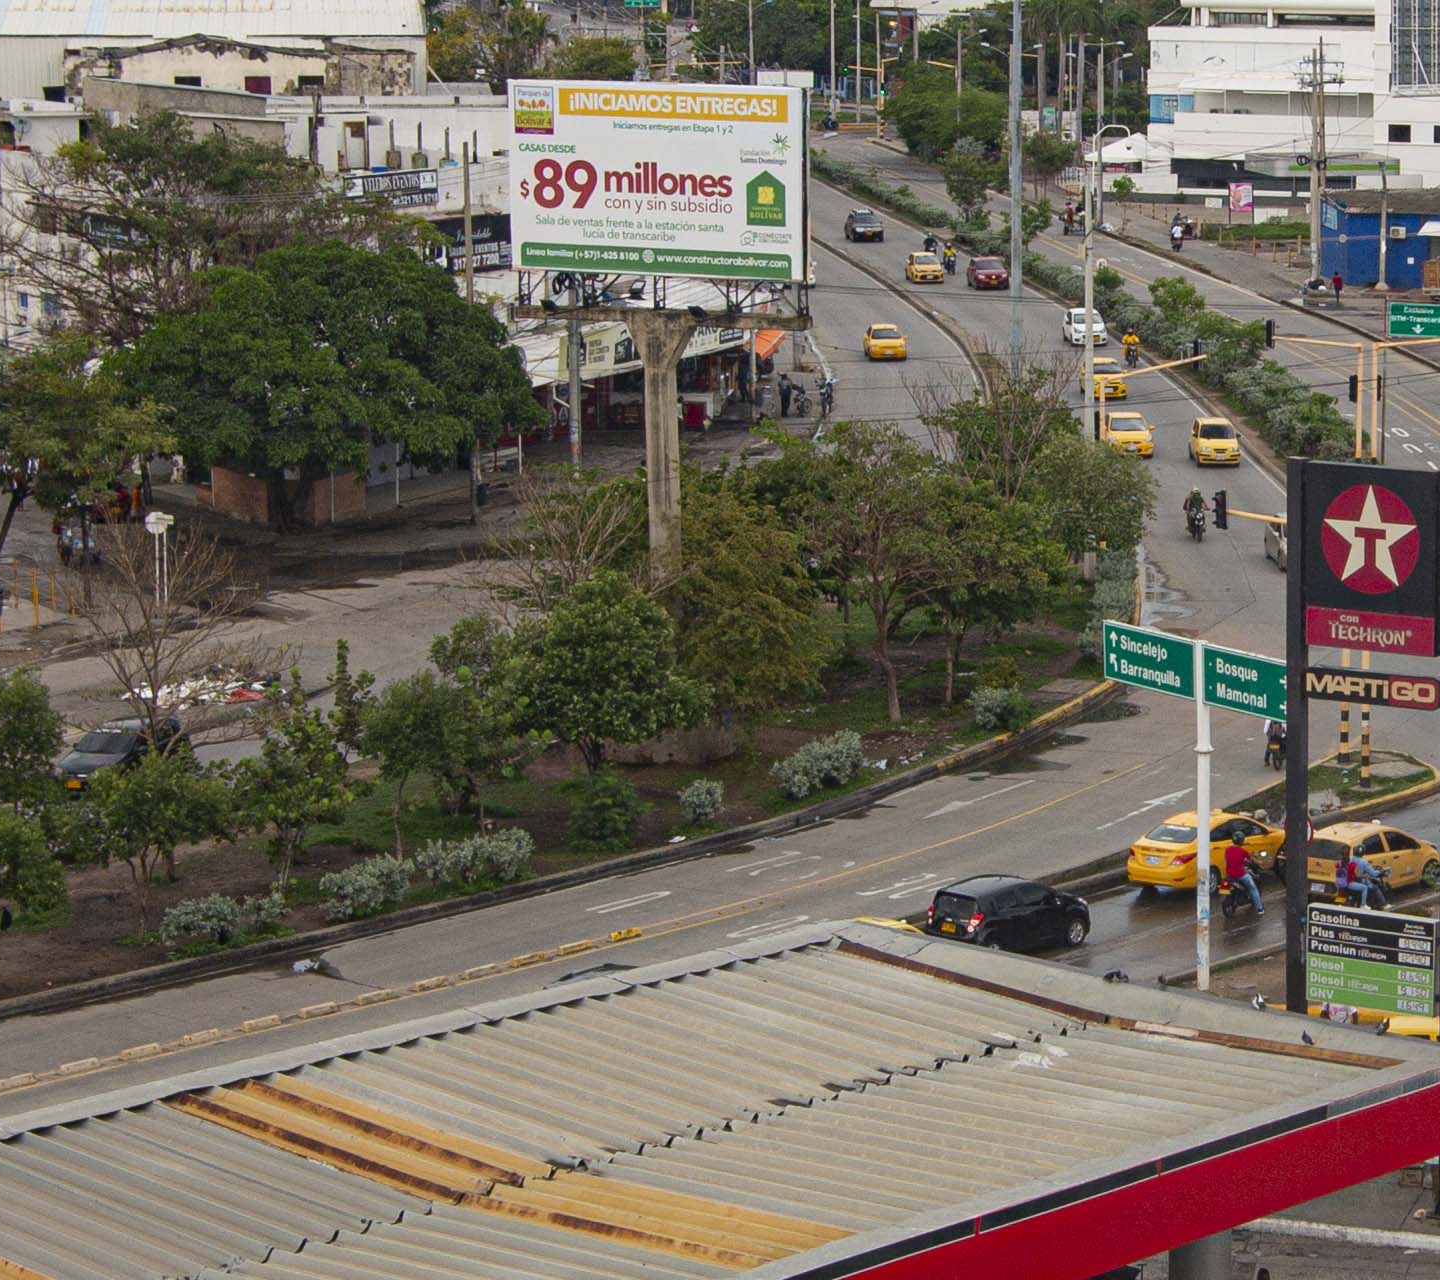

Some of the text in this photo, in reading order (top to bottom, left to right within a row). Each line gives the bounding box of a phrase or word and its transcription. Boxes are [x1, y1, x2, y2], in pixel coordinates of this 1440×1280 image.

[569, 92, 777, 117] ¡INICIAMOS ENTREGAS!
[613, 121, 647, 131] Iniciamos
[692, 124, 714, 134] Etapa
[519, 143, 576, 154] CASAS DESDE
[604, 162, 732, 198] millones
[605, 197, 733, 214] con y sin subsidio
[536, 214, 554, 225] Sala
[557, 215, 569, 226] de
[572, 217, 604, 228] ventas
[606, 216, 634, 229] frente
[644, 218, 653, 229] la
[655, 219, 696, 231] estación
[698, 222, 724, 232] santa
[607, 230, 620, 241] de
[622, 230, 676, 242] transcaribe
[547, 248, 574, 258] familiar
[620, 252, 639, 261] 8100
[657, 254, 788, 269] www.constructorabolivar.com
[1340, 614, 1359, 624] con
[1120, 634, 1168, 662] Sincelejo
[1120, 659, 1181, 688] Barranquilla
[1216, 658, 1258, 682] Bosque
[1216, 682, 1267, 709] Mamonal
[1311, 911, 1360, 927] Gasolina
[1311, 926, 1335, 939] Plus
[1311, 958, 1344, 972] Diesel
[1311, 973, 1344, 987] Diesel
